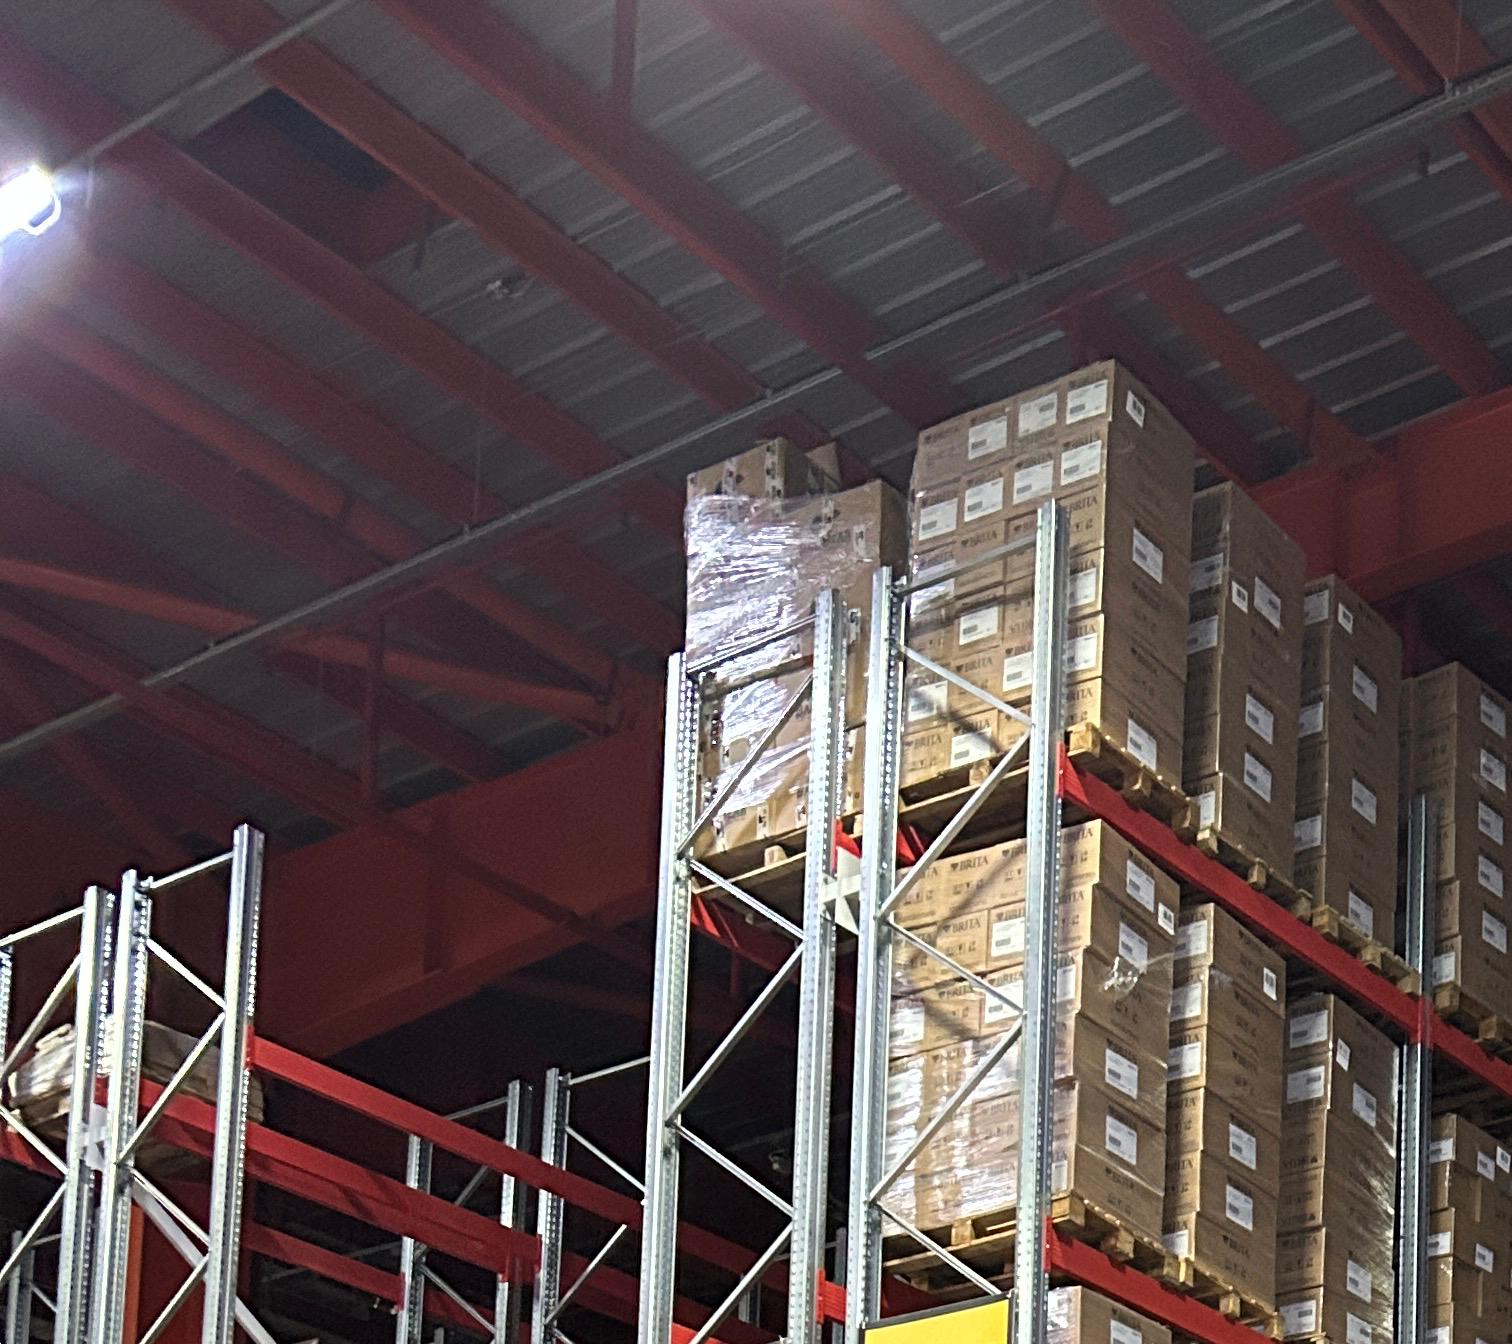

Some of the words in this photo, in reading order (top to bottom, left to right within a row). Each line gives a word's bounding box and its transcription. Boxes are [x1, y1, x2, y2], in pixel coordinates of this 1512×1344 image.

[965, 656, 993, 672] BRITA
[914, 735, 942, 751] BRITA
[960, 855, 988, 870] BRITA
[952, 919, 981, 933] BRITA
